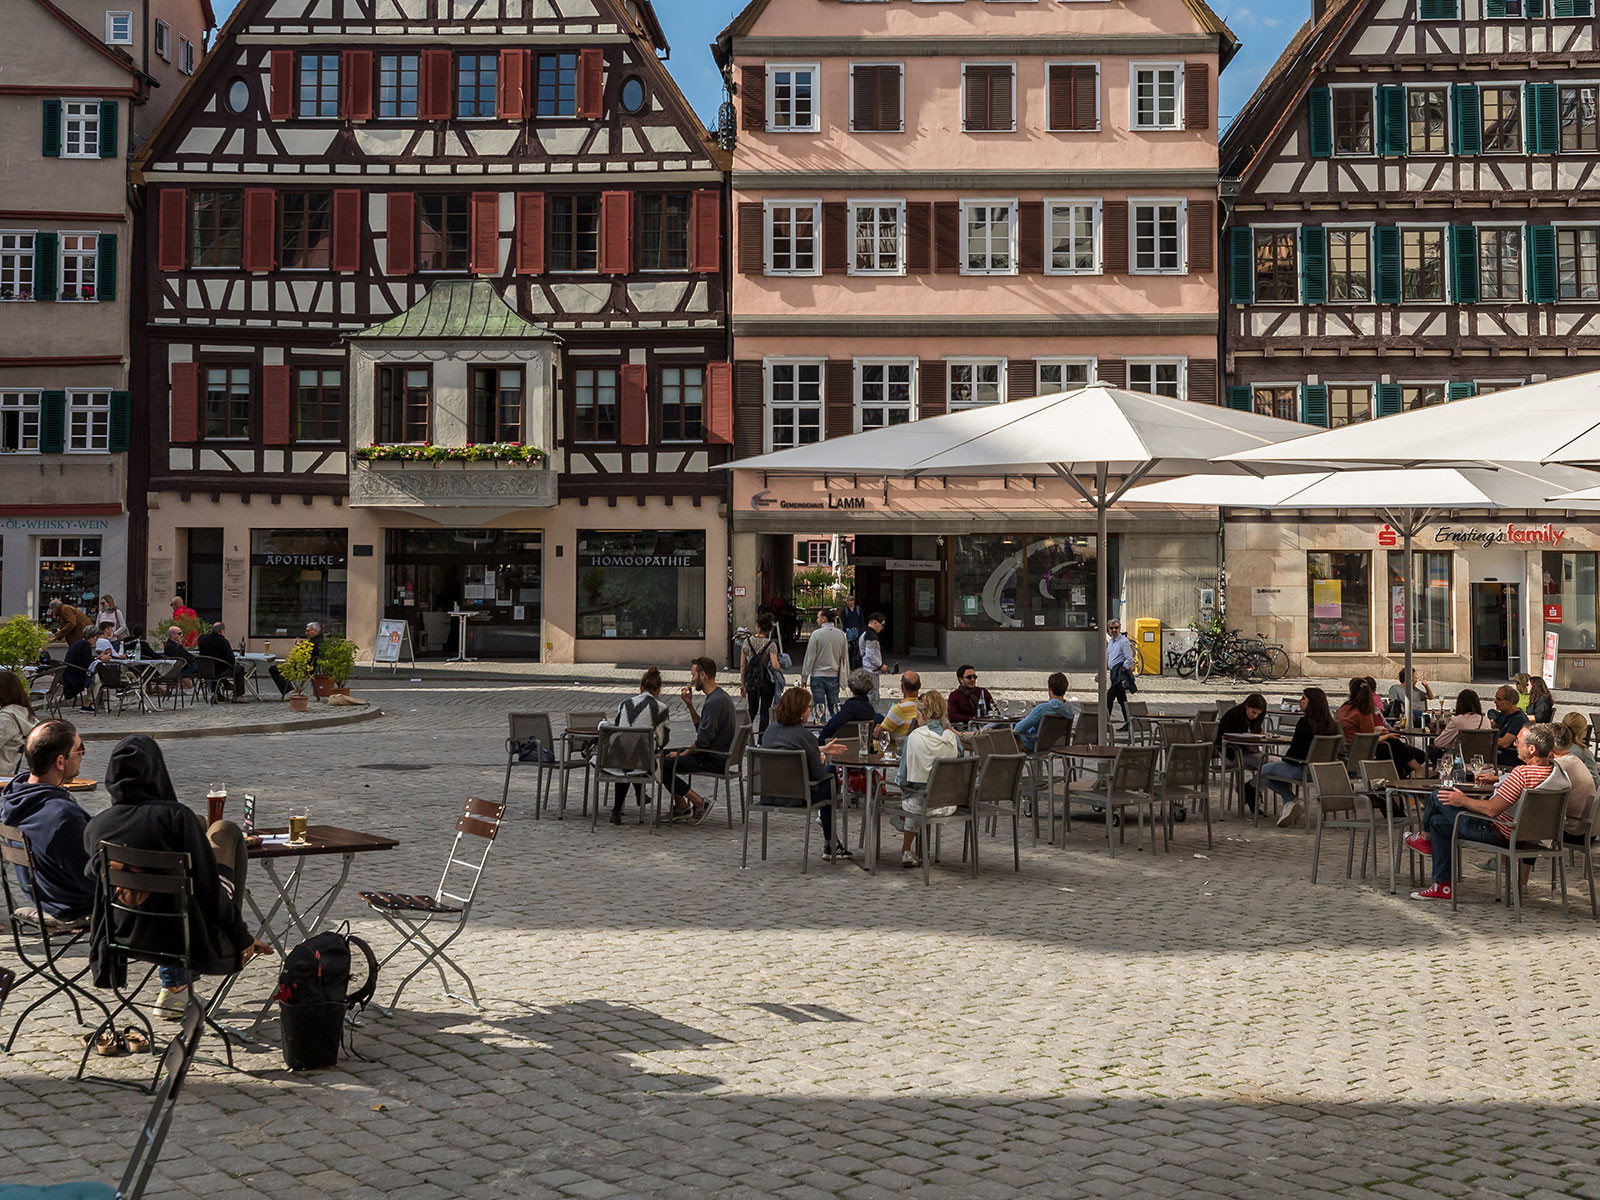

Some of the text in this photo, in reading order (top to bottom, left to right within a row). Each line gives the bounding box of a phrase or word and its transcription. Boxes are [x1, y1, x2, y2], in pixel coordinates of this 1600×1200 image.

[828, 493, 865, 509] LAMM
[26, 520, 73, 529] WHISKY
[77, 520, 108, 529] WEIN
[1435, 523, 1565, 548] Ernsting's family
[265, 555, 334, 565] APOTHEKE
